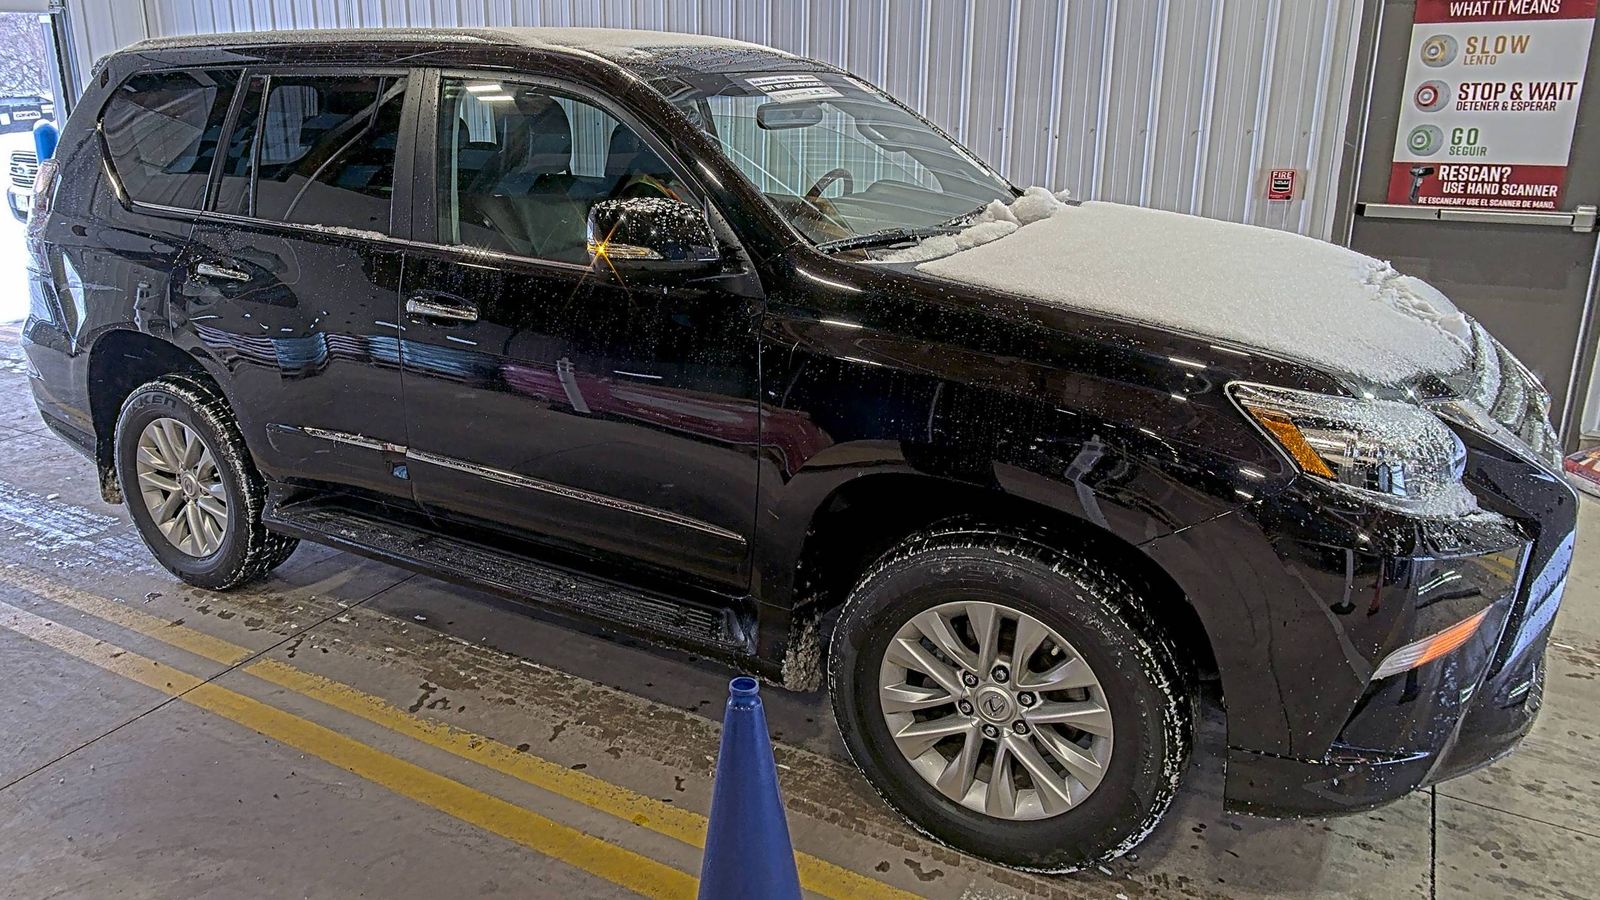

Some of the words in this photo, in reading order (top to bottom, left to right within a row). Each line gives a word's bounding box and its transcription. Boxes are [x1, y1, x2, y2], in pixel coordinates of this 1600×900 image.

[1449, 1, 1490, 16] WHAT
[1492, 1, 1507, 15] IT
[1508, 0, 1561, 15] MEANS
[1466, 35, 1530, 54] SLOW
[1464, 55, 1497, 65] LENTO
[1458, 82, 1505, 100] STOP
[1510, 83, 1523, 100] &
[1529, 82, 1578, 101] WAIT
[1456, 101, 1498, 111] DETENER
[1501, 102, 1509, 111] &
[1511, 101, 1556, 111] ESPERAR
[1451, 128, 1479, 145] GO
[1449, 147, 1487, 156] SEGUIR
[1273, 171, 1292, 179] FIRE
[1438, 166, 1511, 182] RESCAN?
[1443, 182, 1465, 194] USE
[1467, 183, 1499, 195] HAND
[1501, 184, 1558, 197] SCANNER
[1418, 196, 1427, 204] RE
[1428, 197, 1465, 205] ESCANEAR?
